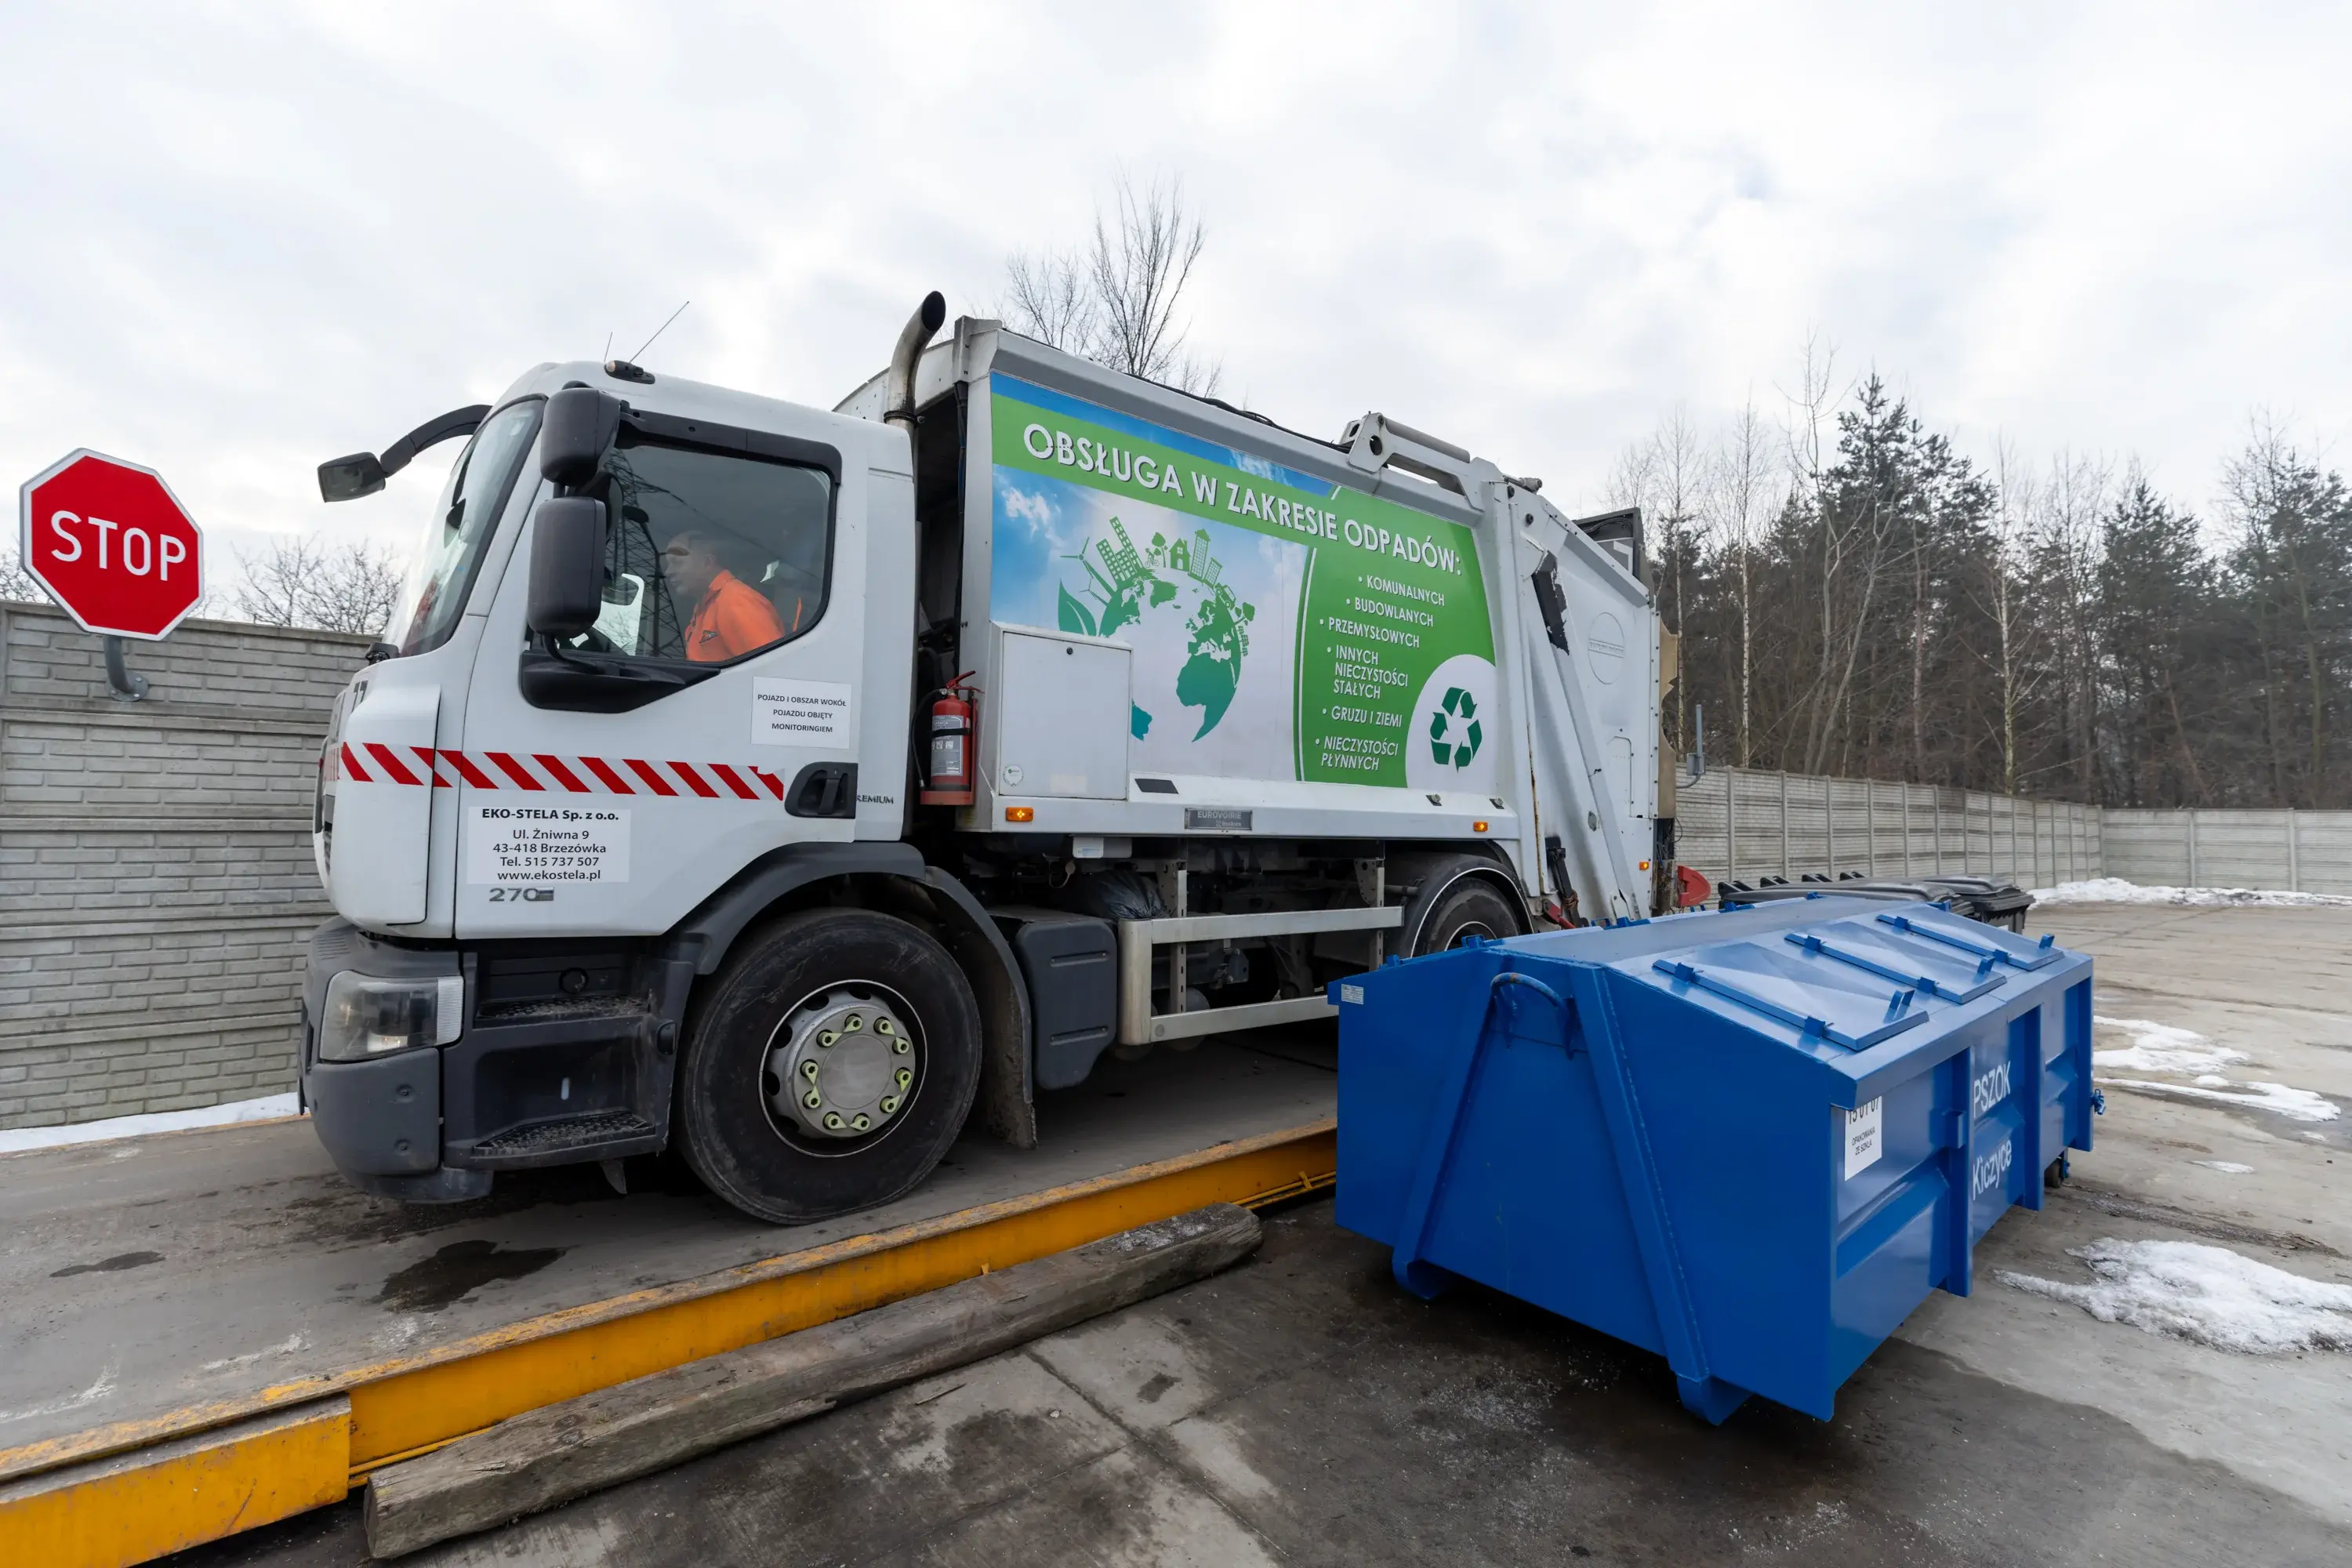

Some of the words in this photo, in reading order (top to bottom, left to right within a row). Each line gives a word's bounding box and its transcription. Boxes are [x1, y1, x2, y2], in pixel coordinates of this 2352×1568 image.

[1023, 423, 1184, 498] OBSŁUGA
[1191, 470, 1217, 506] W
[1225, 482, 1338, 541] ZAKRESIE
[1344, 519, 1461, 575] ODPADÓW:
[50, 510, 187, 582] STOP
[1367, 575, 1445, 607] KOMUNALNYCH
[1355, 597, 1434, 627] BUDOWLANYCH
[1328, 616, 1420, 648] PRZEMYSŁOWYCH
[1336, 644, 1378, 666] INNYCH
[1335, 662, 1408, 688] NIECZYSTOŚCI
[1334, 679, 1381, 699] STAŁYCH
[757, 694, 785, 702] POJAZD
[791, 696, 819, 705] OBSZAR
[773, 709, 806, 717] POJAZDU
[807, 711, 833, 720] OBJĘTY
[1331, 706, 1367, 724] GRUZU
[1370, 710, 1374, 724] I
[1376, 711, 1403, 728] ZIEMI
[771, 723, 833, 733] MONITORINGIEM
[1324, 735, 1399, 757] NIECZYSTOŚCI
[1321, 753, 1380, 771] PŁYNNYCH
[857, 794, 894, 804] REMIUM
[482, 808, 559, 819] EKO-STELA
[562, 810, 583, 822] Sp.
[1197, 811, 1242, 819] EUROVOIRIE
[513, 829, 529, 840] Ul.
[532, 828, 579, 840] Żniwna
[582, 830, 590, 840] 9
[492, 843, 537, 853] 43-418
[541, 842, 606, 853] Brzezówka
[500, 856, 521, 866] Tel.
[524, 857, 547, 866] 515
[551, 857, 574, 866] 737
[577, 857, 599, 866] 507
[497, 869, 601, 881] www.ekostela.pl
[489, 887, 539, 902] 270
[1973, 1061, 2011, 1119] PSZOK
[1973, 1139, 2012, 1200] Kiczyce
